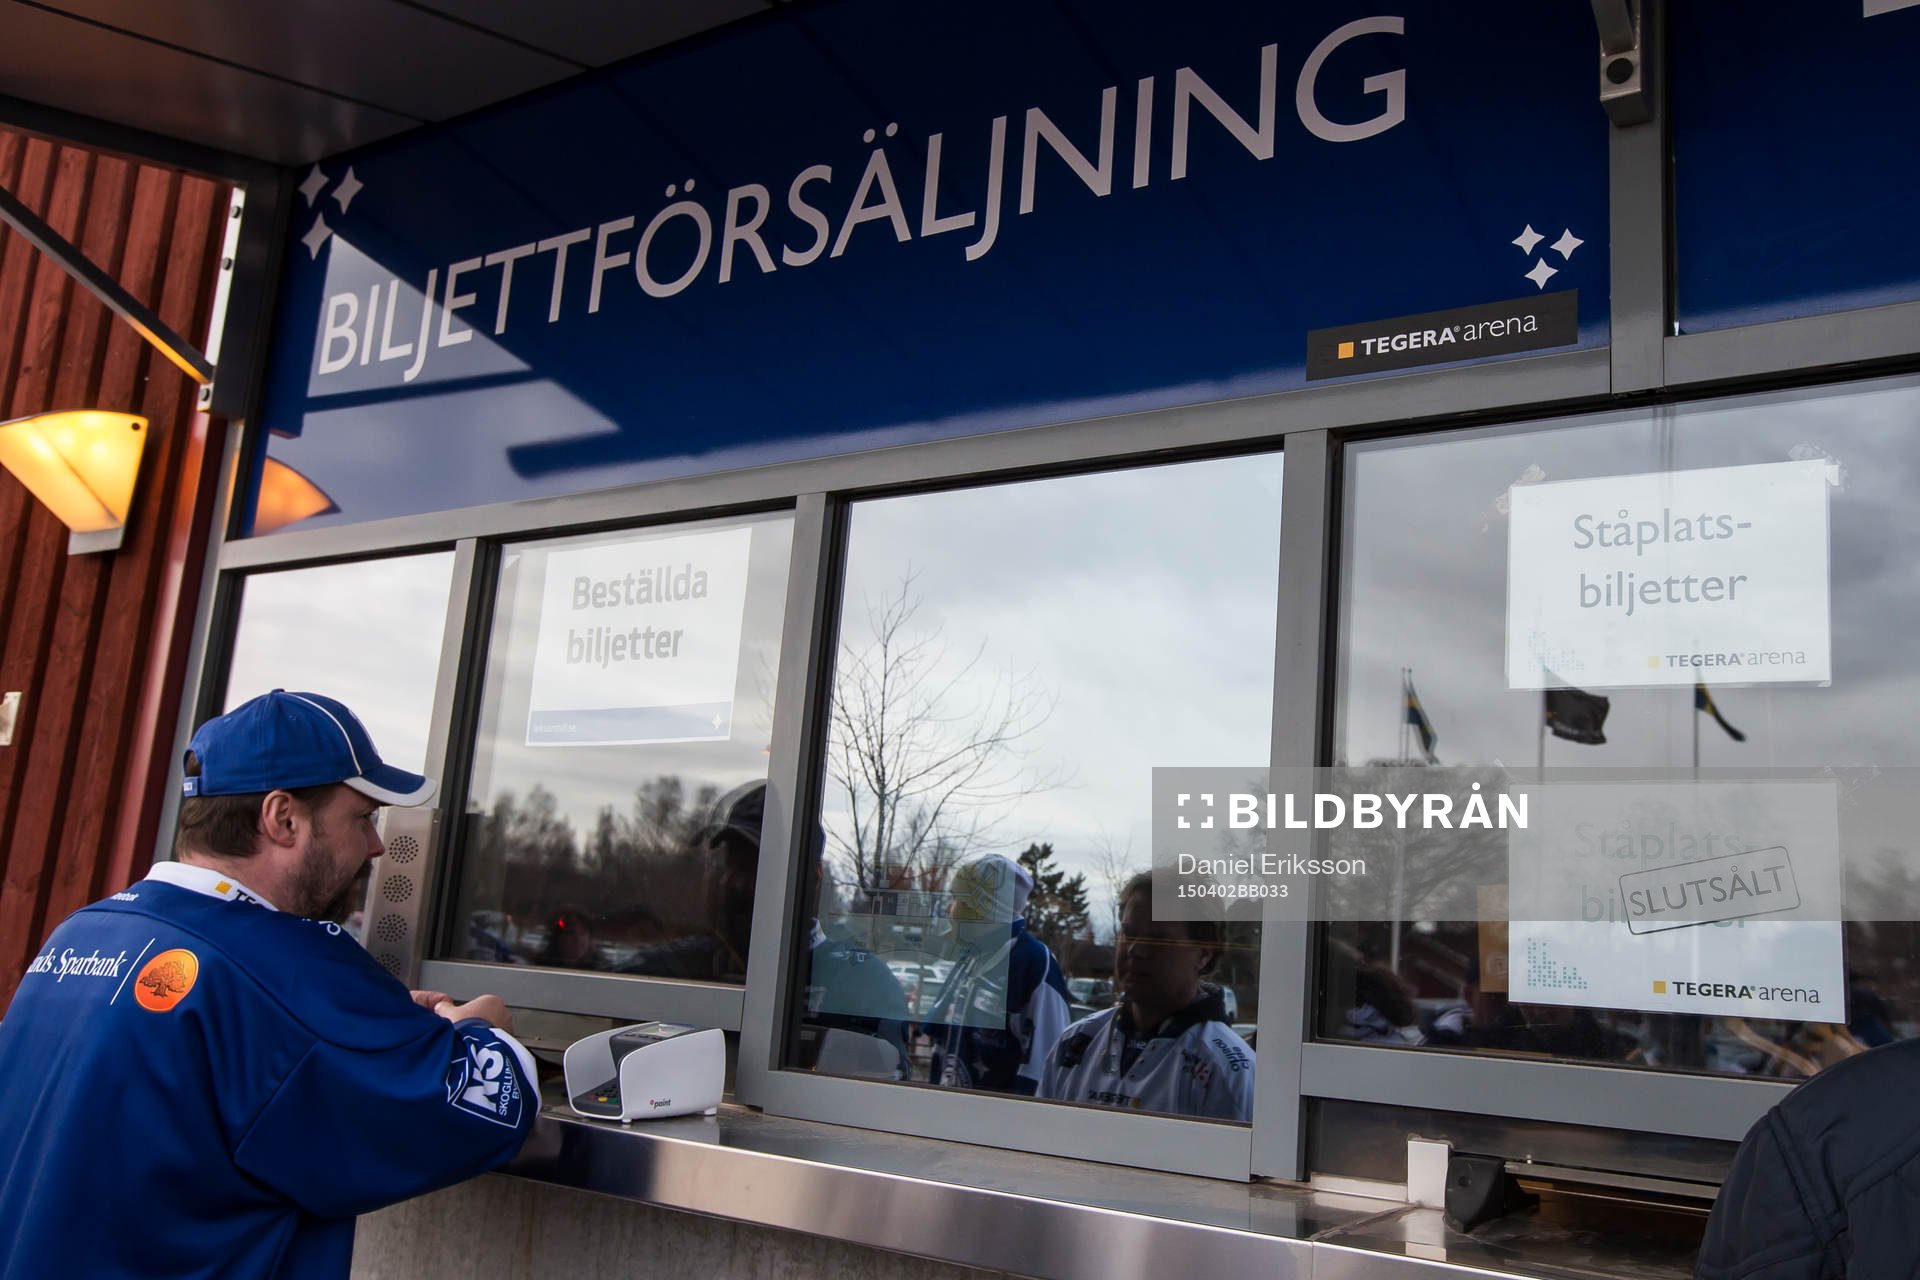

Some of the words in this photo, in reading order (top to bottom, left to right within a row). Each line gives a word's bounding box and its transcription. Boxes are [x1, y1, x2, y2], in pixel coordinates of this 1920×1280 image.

[318, 15, 1407, 382] BILJETTFÖRSÄLJNING
[1463, 314, 1538, 342] arena
[1573, 507, 1752, 556] Ståplats-
[572, 563, 708, 611] Beställda
[1579, 571, 1748, 617] biljetter
[566, 625, 684, 669] biljetter
[1747, 651, 1806, 666] arena
[1628, 865, 1786, 918] SLUTSÅLT
[54, 947, 128, 983] Sparbank
[1758, 985, 1821, 1004] arena
